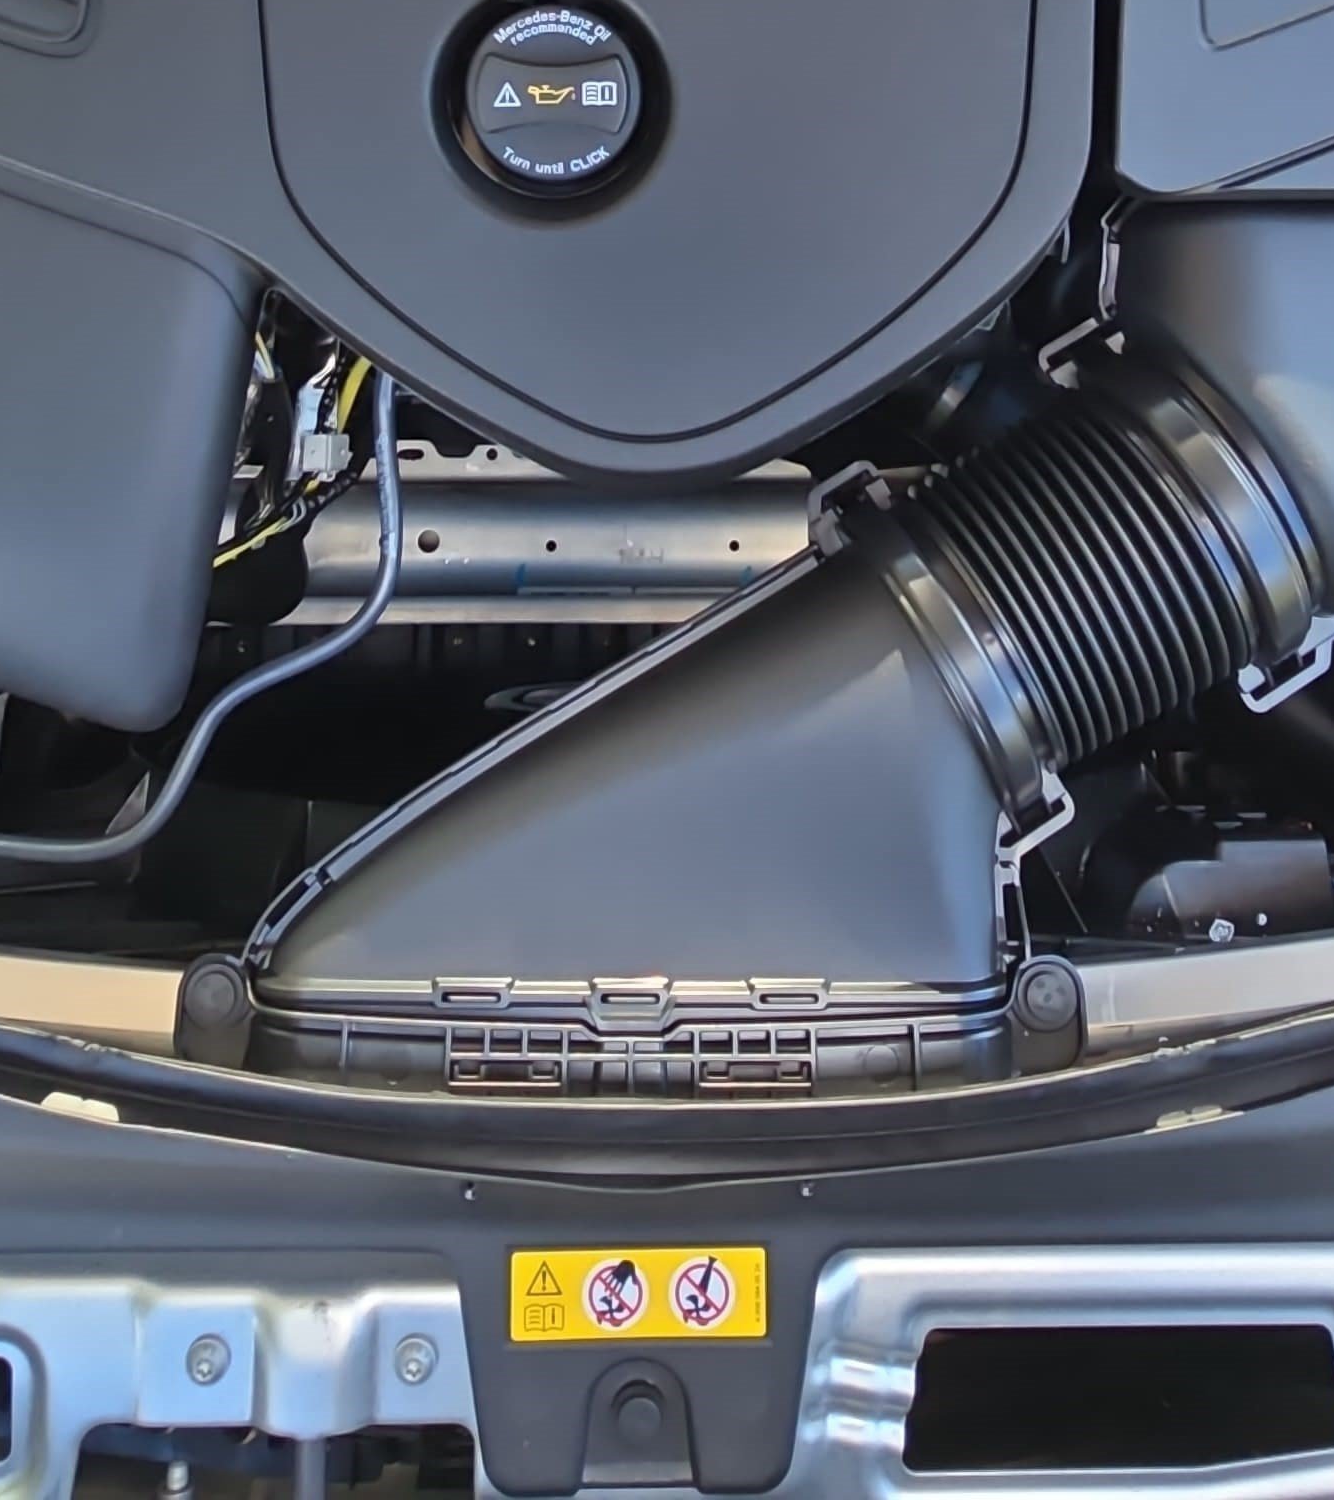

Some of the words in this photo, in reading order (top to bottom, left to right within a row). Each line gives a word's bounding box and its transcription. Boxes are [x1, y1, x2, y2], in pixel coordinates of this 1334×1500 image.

[493, 10, 593, 43] Mercedes-Benz
[594, 24, 611, 42] Oil
[510, 23, 597, 46] recommended
[503, 146, 530, 170] Turn
[535, 162, 565, 175] until
[569, 145, 610, 172] CLICK
